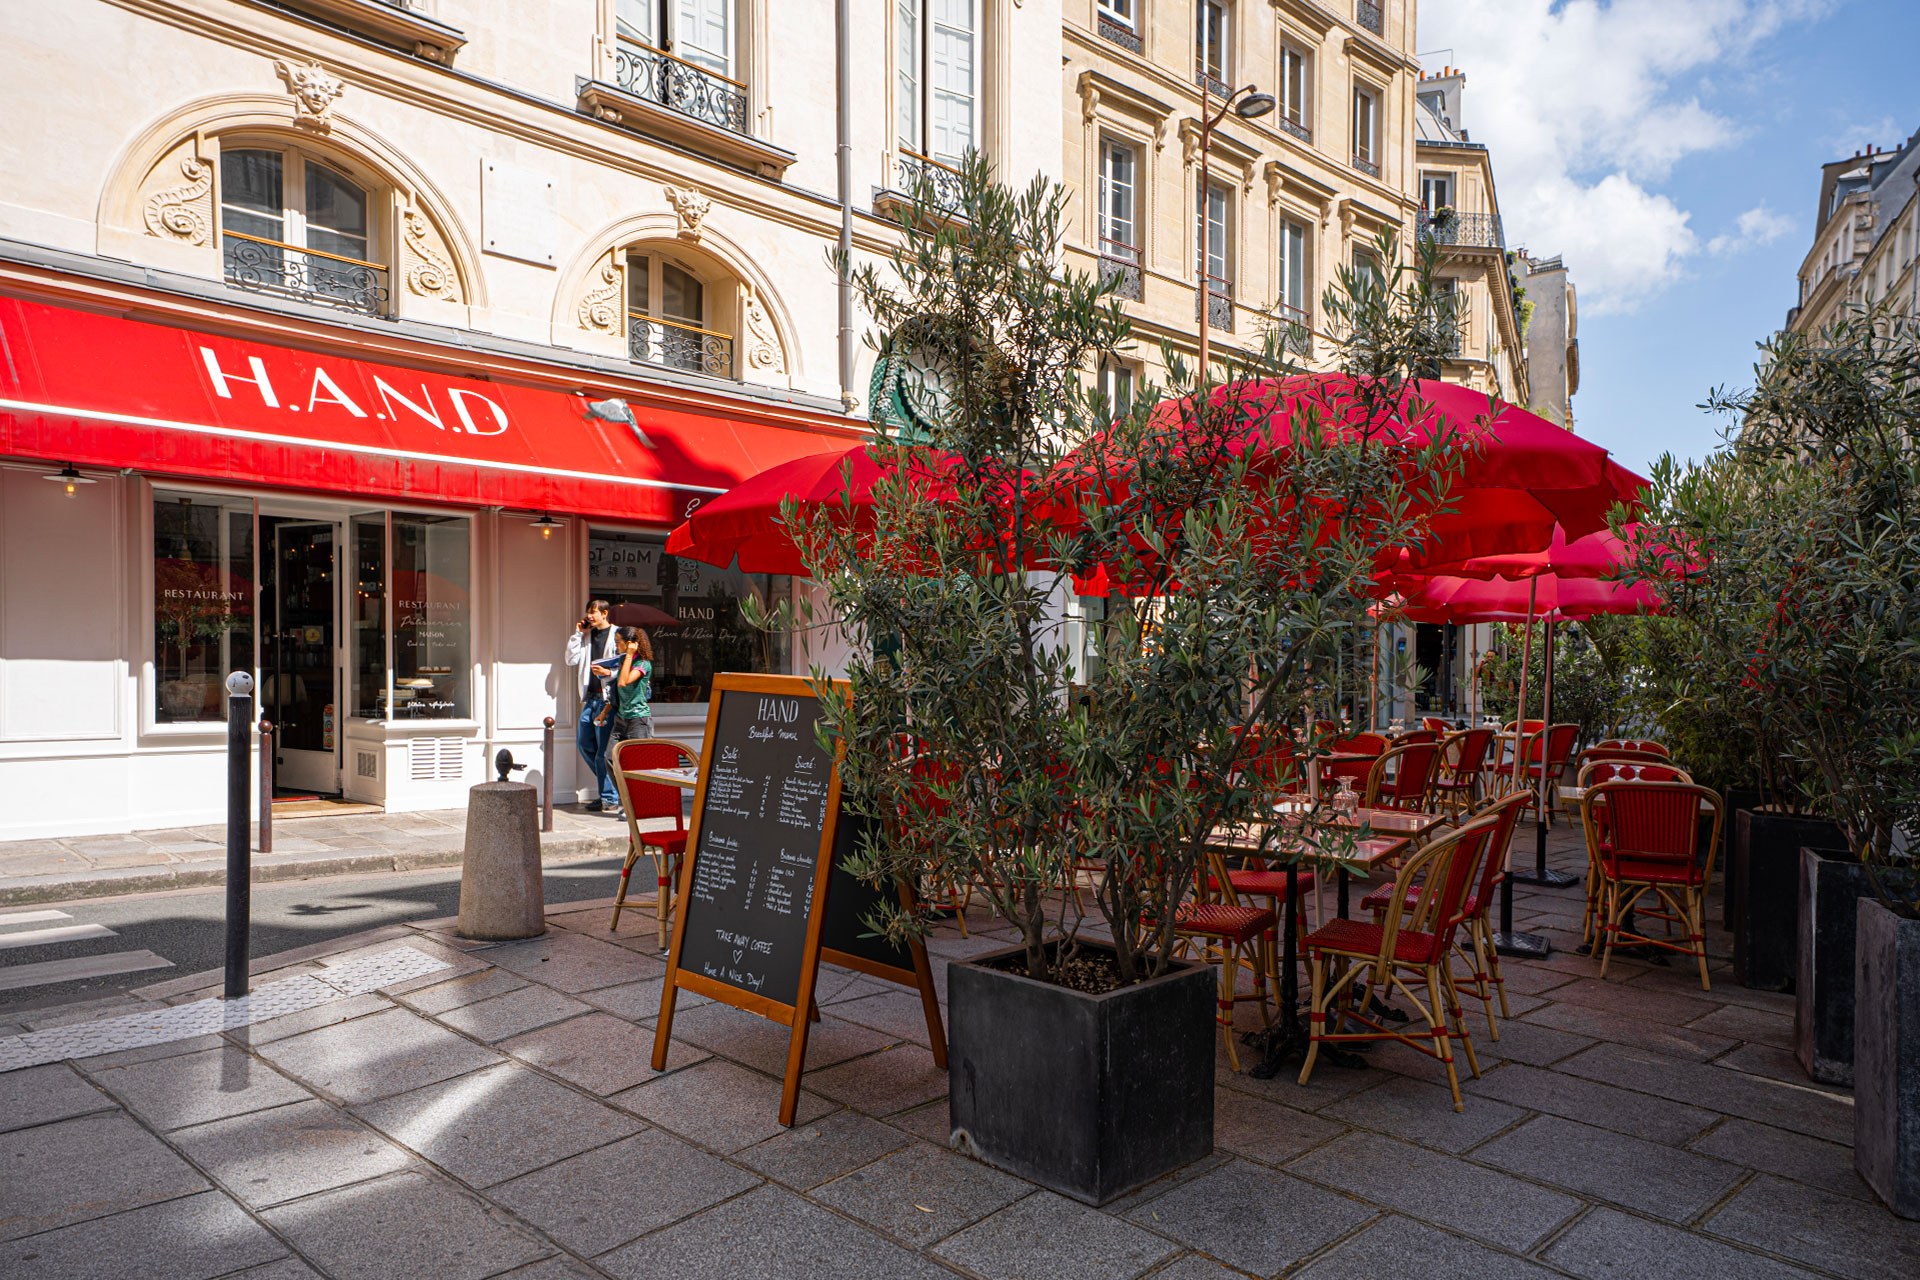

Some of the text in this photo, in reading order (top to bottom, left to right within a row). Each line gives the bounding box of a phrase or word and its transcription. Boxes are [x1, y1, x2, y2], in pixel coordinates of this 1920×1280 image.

[200, 346, 508, 436] H.A.N.D
[164, 588, 244, 601] RESTAURANT
[399, 600, 461, 610] RESTAURANT
[757, 697, 799, 723] HAND
[716, 929, 734, 943] TAKE
[750, 939, 774, 954] COFFEE
